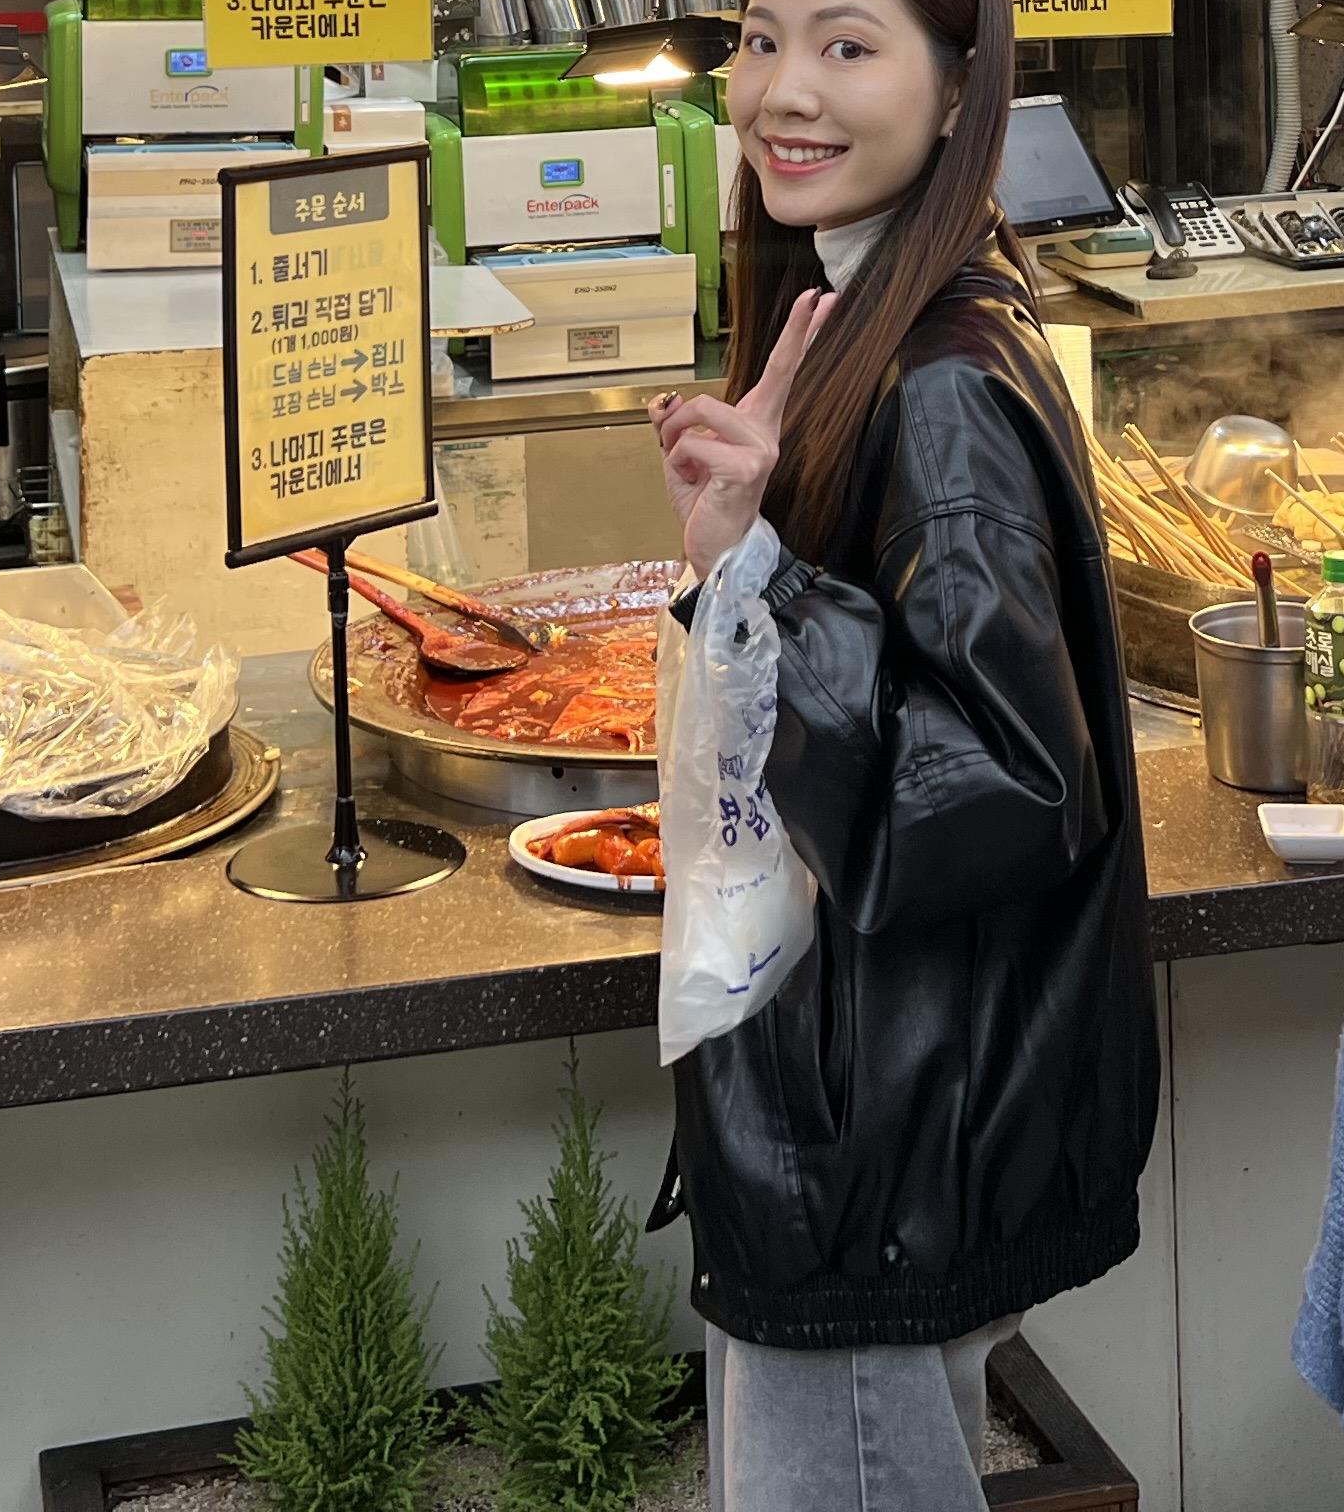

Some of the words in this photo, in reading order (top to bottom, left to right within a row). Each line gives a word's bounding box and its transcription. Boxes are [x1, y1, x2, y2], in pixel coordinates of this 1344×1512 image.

[251, 13, 360, 41] 카운터에서
[294, 194, 327, 224] 주문
[332, 190, 366, 220] 순서
[526, 193, 600, 214] Enterpack
[250, 260, 264, 286] 1.
[272, 248, 328, 284] 줄서기
[271, 300, 309, 333] 튀김
[315, 293, 351, 326] 직접
[358, 286, 394, 318] 담기
[272, 332, 297, 357] (1개
[300, 322, 360, 353] 1,000원)
[272, 359, 302, 389] 드실
[307, 353, 338, 382] 손님
[371, 338, 405, 369] 접시
[272, 391, 302, 420] 포장
[307, 384, 338, 412] 손님
[371, 370, 406, 398] 박스
[270, 430, 325, 469] 나머지
[331, 417, 388, 455] 주문은
[270, 454, 363, 501] 카운터에서
